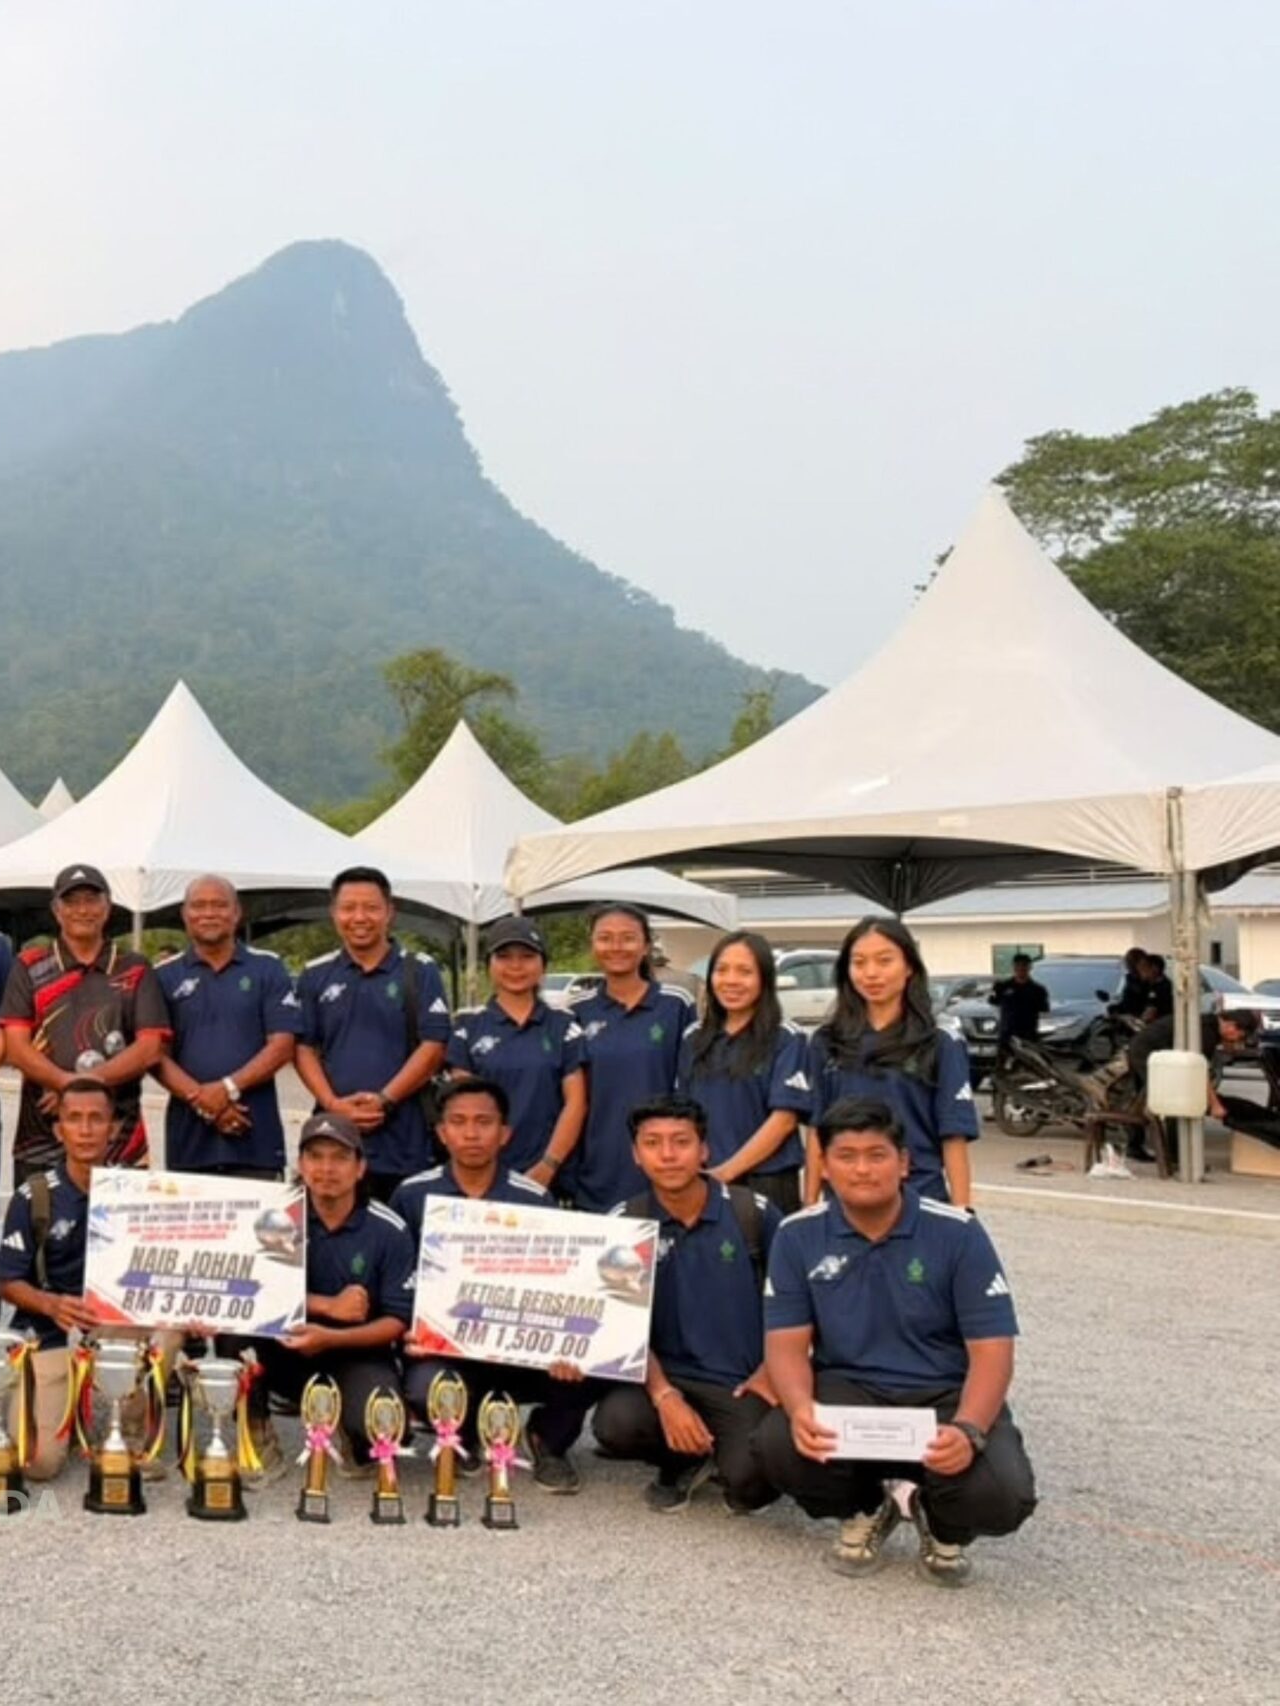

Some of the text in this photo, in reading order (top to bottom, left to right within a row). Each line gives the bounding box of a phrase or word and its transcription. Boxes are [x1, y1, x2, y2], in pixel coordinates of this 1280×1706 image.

[128, 1246, 255, 1279] NAIB JOHAN
[122, 1289, 155, 1313] RM
[456, 1281, 606, 1319] KETIGA BERSAMA
[454, 1320, 489, 1345] RM
